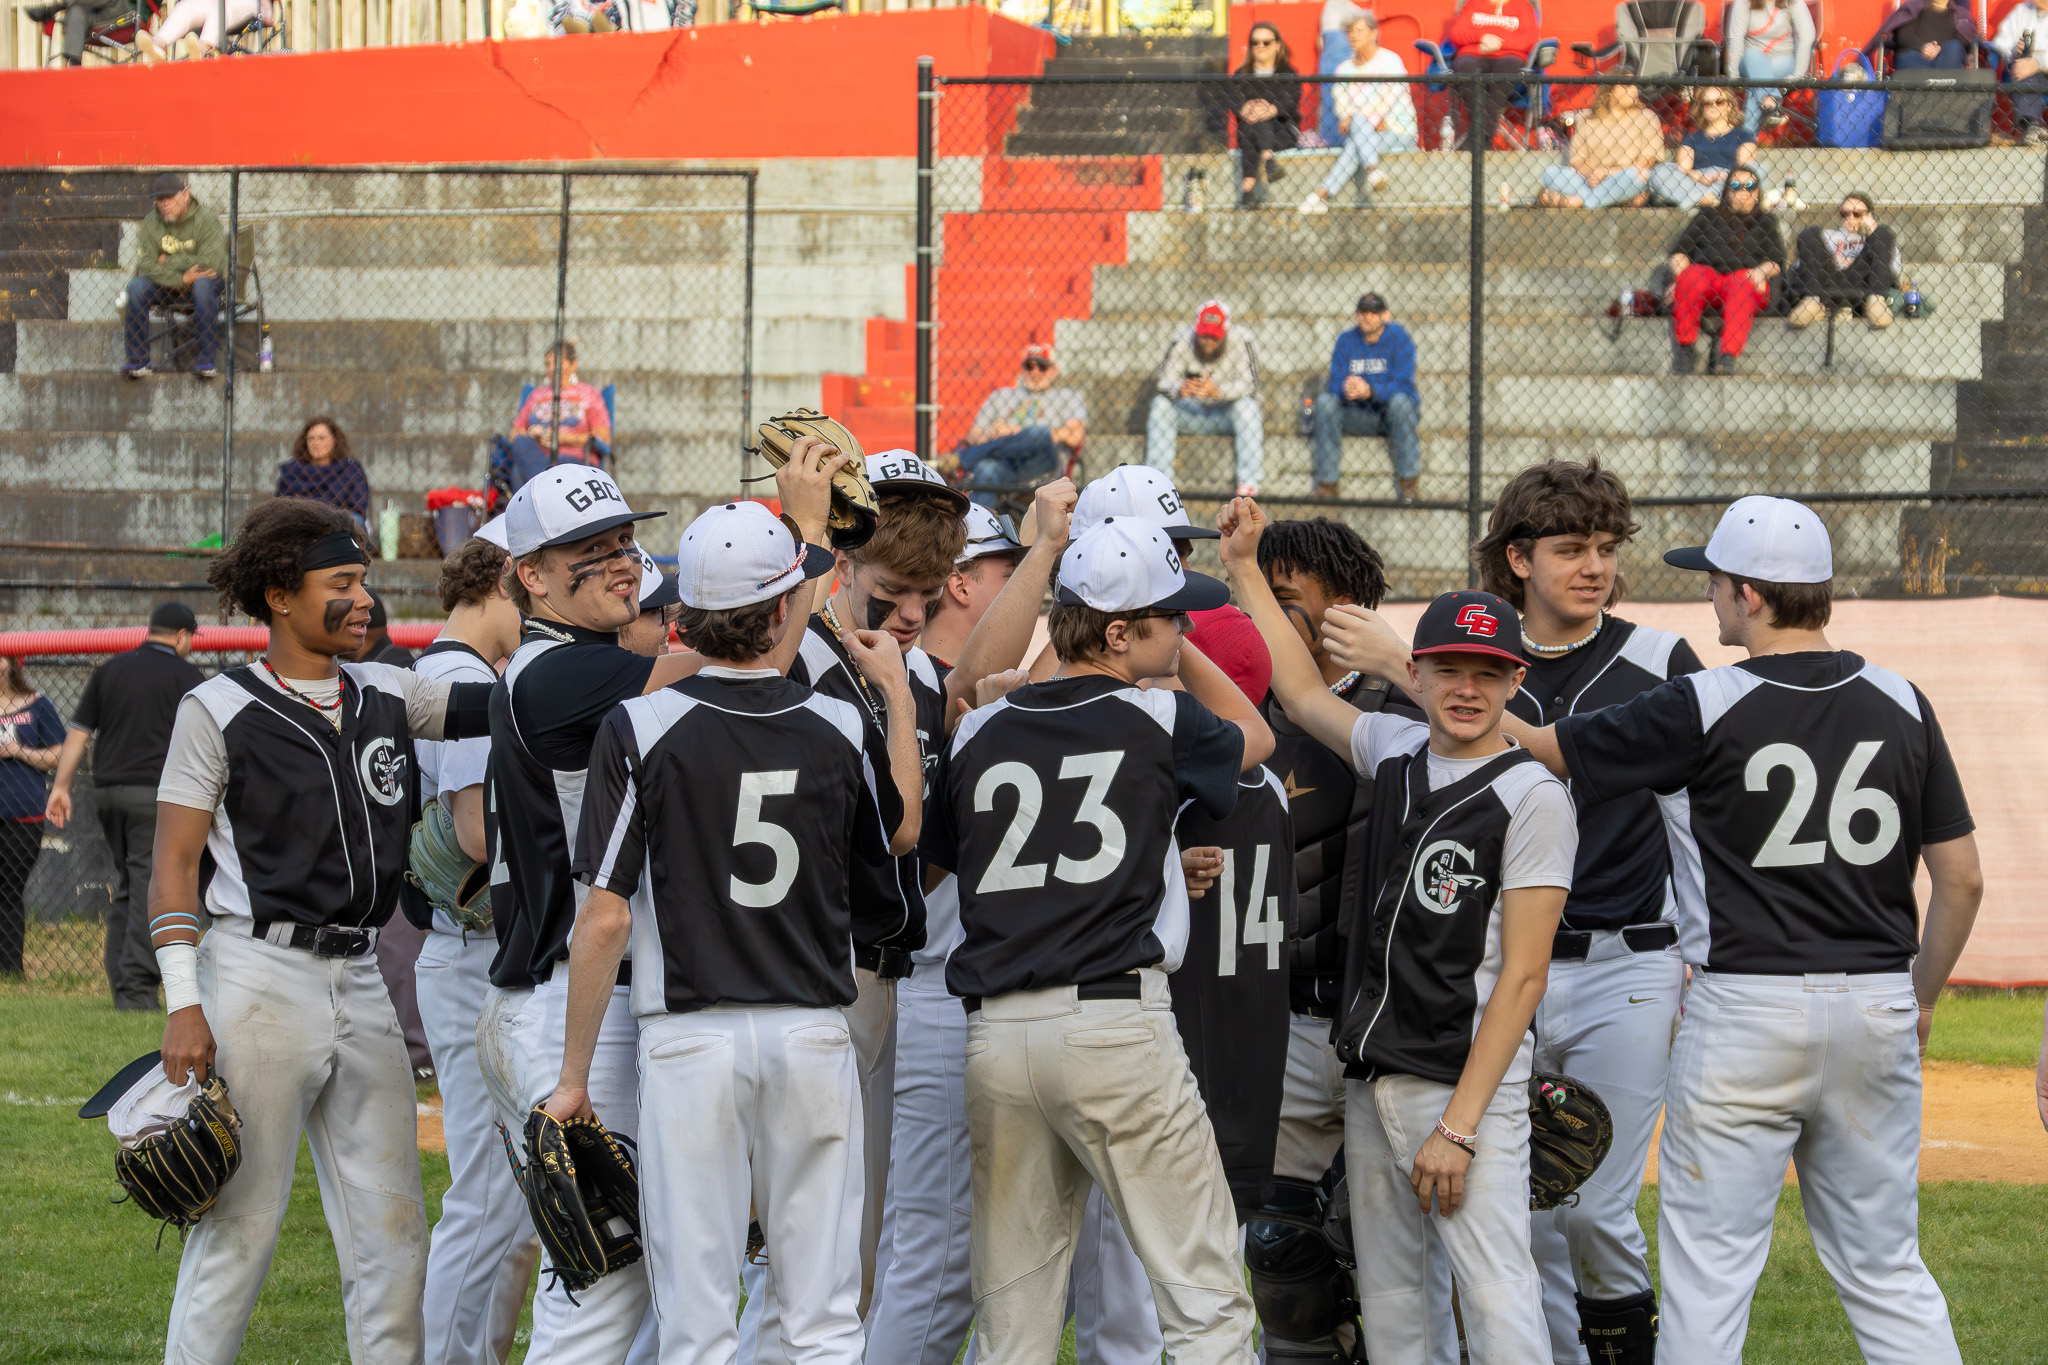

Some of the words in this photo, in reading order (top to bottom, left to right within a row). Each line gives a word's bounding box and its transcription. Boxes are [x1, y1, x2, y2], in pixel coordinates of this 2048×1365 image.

[565, 479, 622, 512] GBC
[730, 769, 799, 907] 5
[973, 750, 1127, 893] 23
[1744, 740, 1901, 867] 26
[1218, 844, 1284, 976] 14
[210, 1122, 234, 1157] A2000
[1446, 1131, 1466, 1143] PLAY
[1602, 1326, 1627, 1336] GLORY
